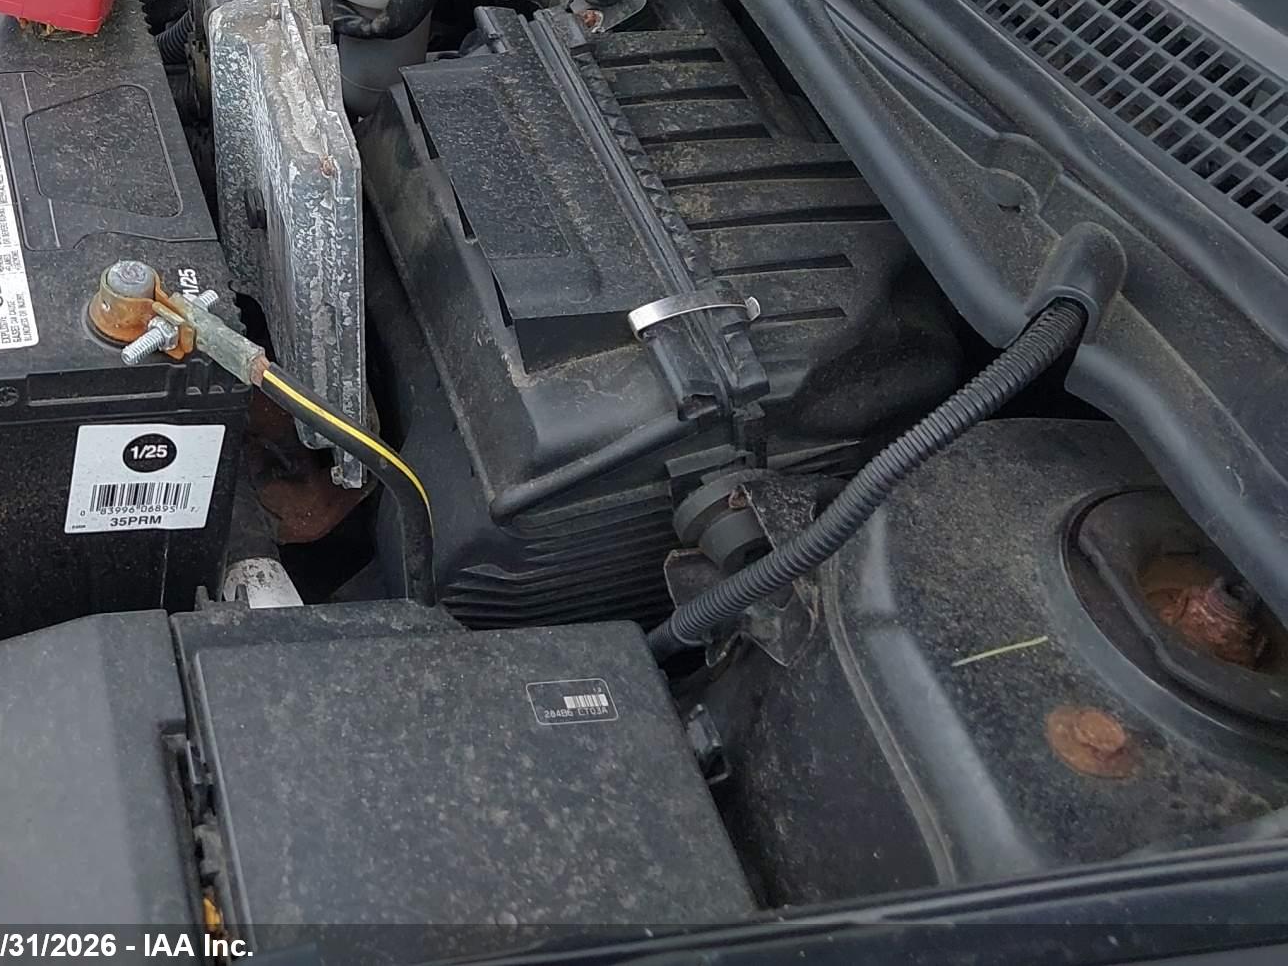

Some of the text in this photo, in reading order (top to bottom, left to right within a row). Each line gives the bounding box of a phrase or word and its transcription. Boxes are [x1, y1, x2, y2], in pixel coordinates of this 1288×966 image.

[130, 444, 168, 460] 1/25
[80, 509, 86, 517] 0
[100, 507, 135, 516] 83996
[141, 505, 176, 514] 06895
[110, 515, 162, 528] 35PRM
